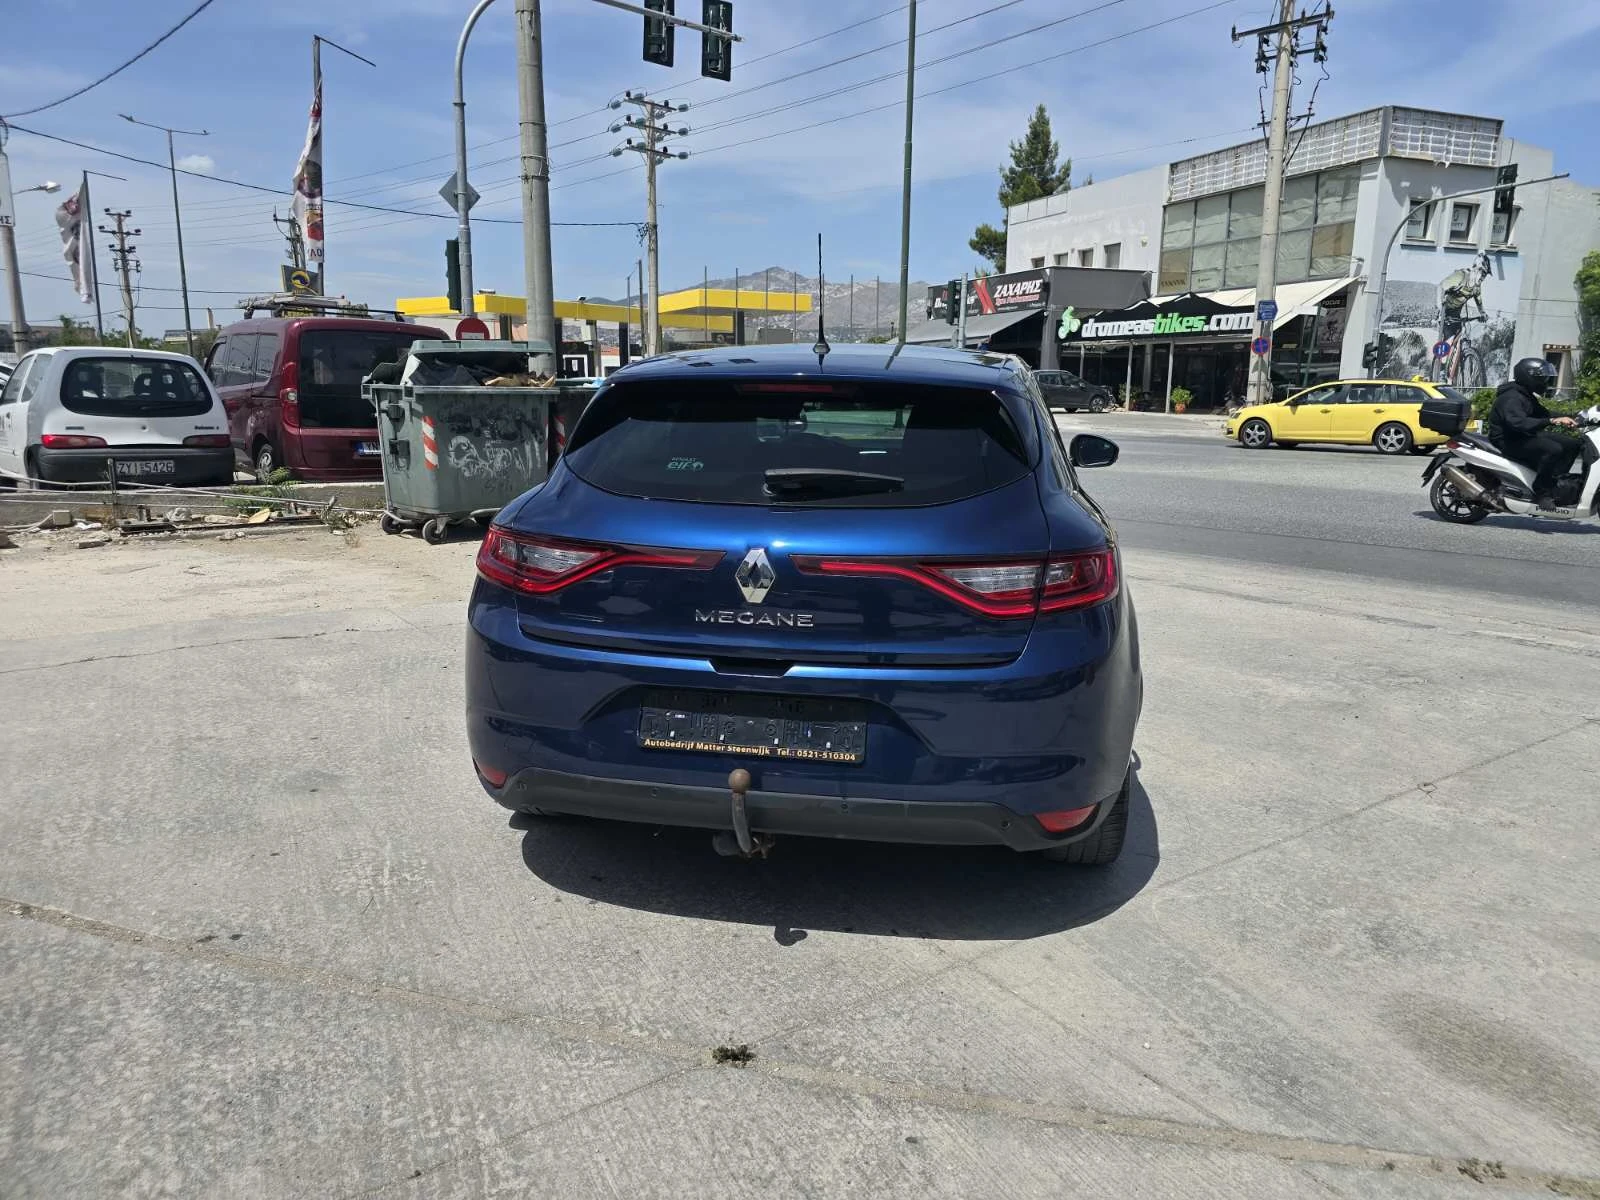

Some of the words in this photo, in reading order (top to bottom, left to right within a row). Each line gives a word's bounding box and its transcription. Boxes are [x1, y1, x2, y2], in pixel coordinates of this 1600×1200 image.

[993, 279, 1043, 298] ΖΑΧΑΡΗΣ
[1081, 312, 1254, 338] dromeasbikes.com
[695, 609, 814, 627] MEGANE
[644, 738, 695, 751] Autobedrijf
[696, 742, 725, 752] Matter
[727, 745, 770, 756] Steenwijk
[796, 750, 856, 761] 0521-510304
